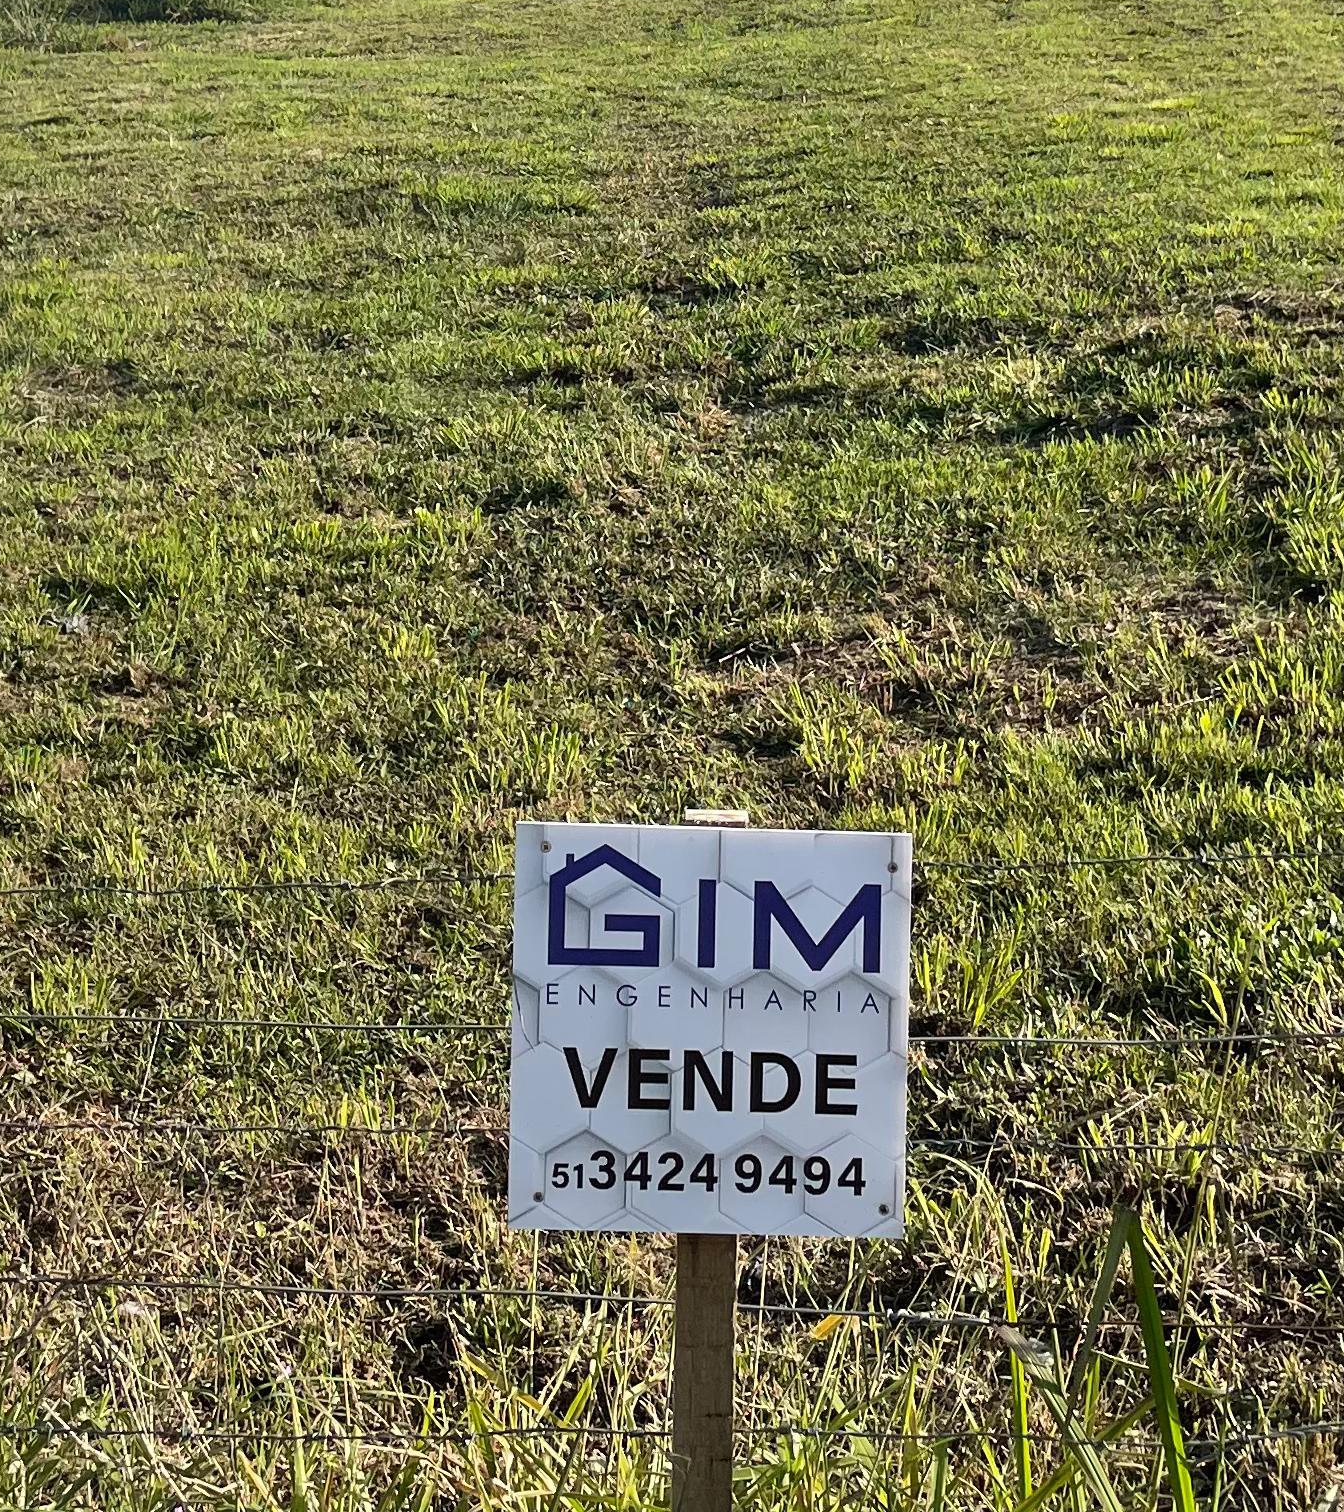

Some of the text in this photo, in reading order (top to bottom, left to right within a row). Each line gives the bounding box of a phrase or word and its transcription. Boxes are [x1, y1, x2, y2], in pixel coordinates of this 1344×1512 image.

[547, 843, 882, 974] GIM
[546, 982, 881, 1015] ENGENHARIA
[562, 1046, 858, 1116] VENDE
